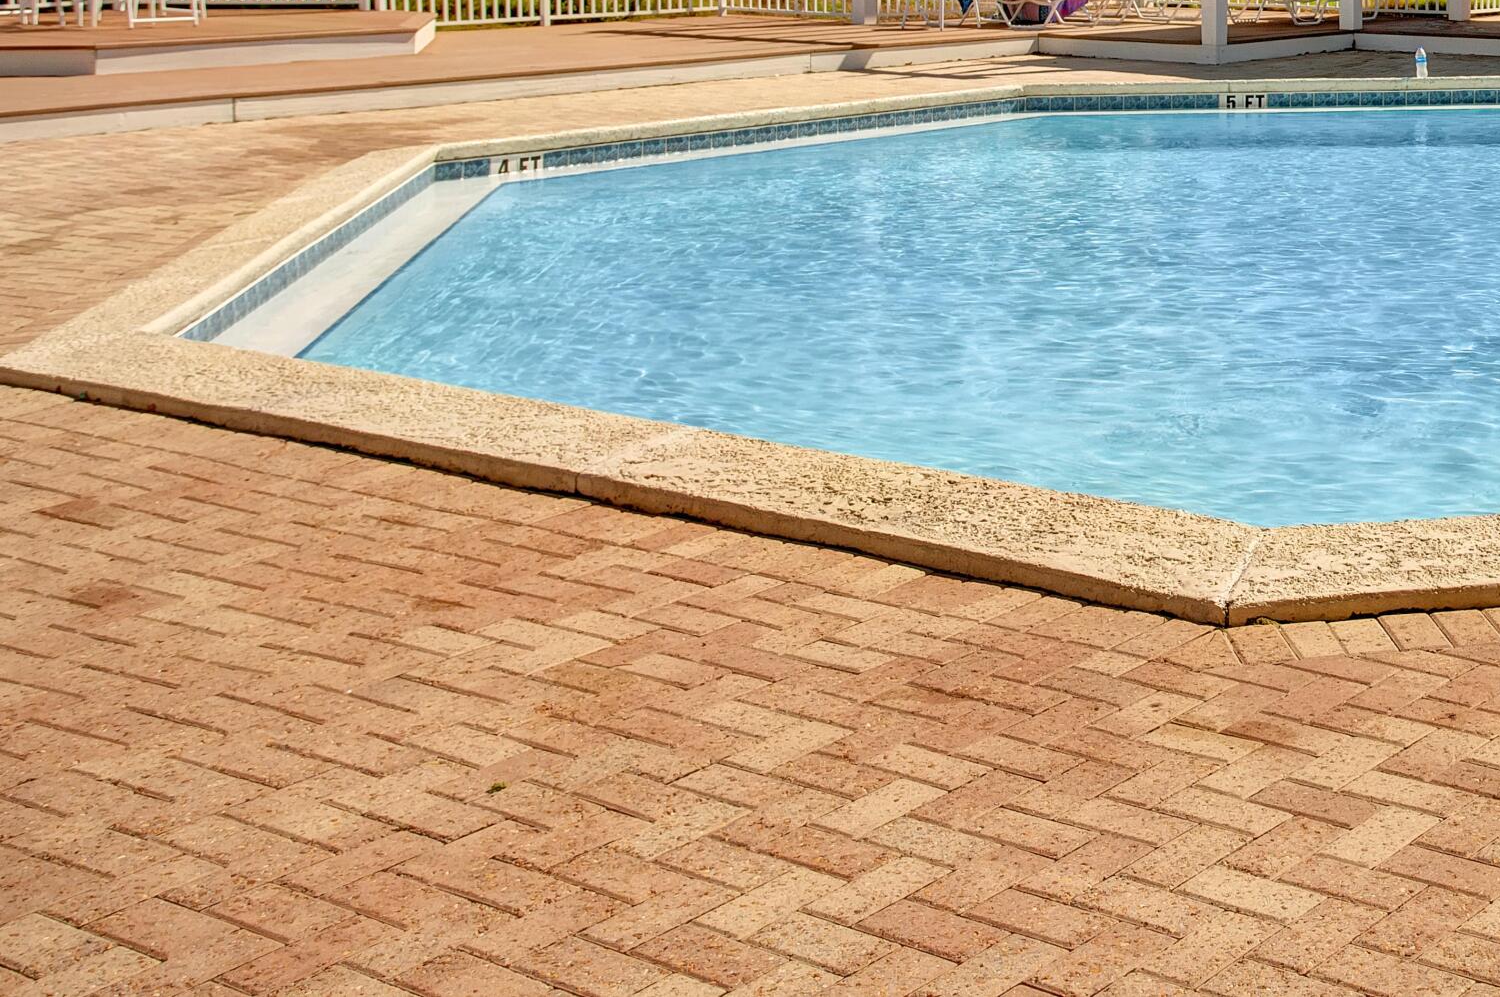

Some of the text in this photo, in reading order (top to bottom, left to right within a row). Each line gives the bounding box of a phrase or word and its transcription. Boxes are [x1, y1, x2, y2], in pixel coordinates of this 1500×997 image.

[1226, 94, 1265, 108] 5 FT
[498, 155, 541, 174] 4 FT
